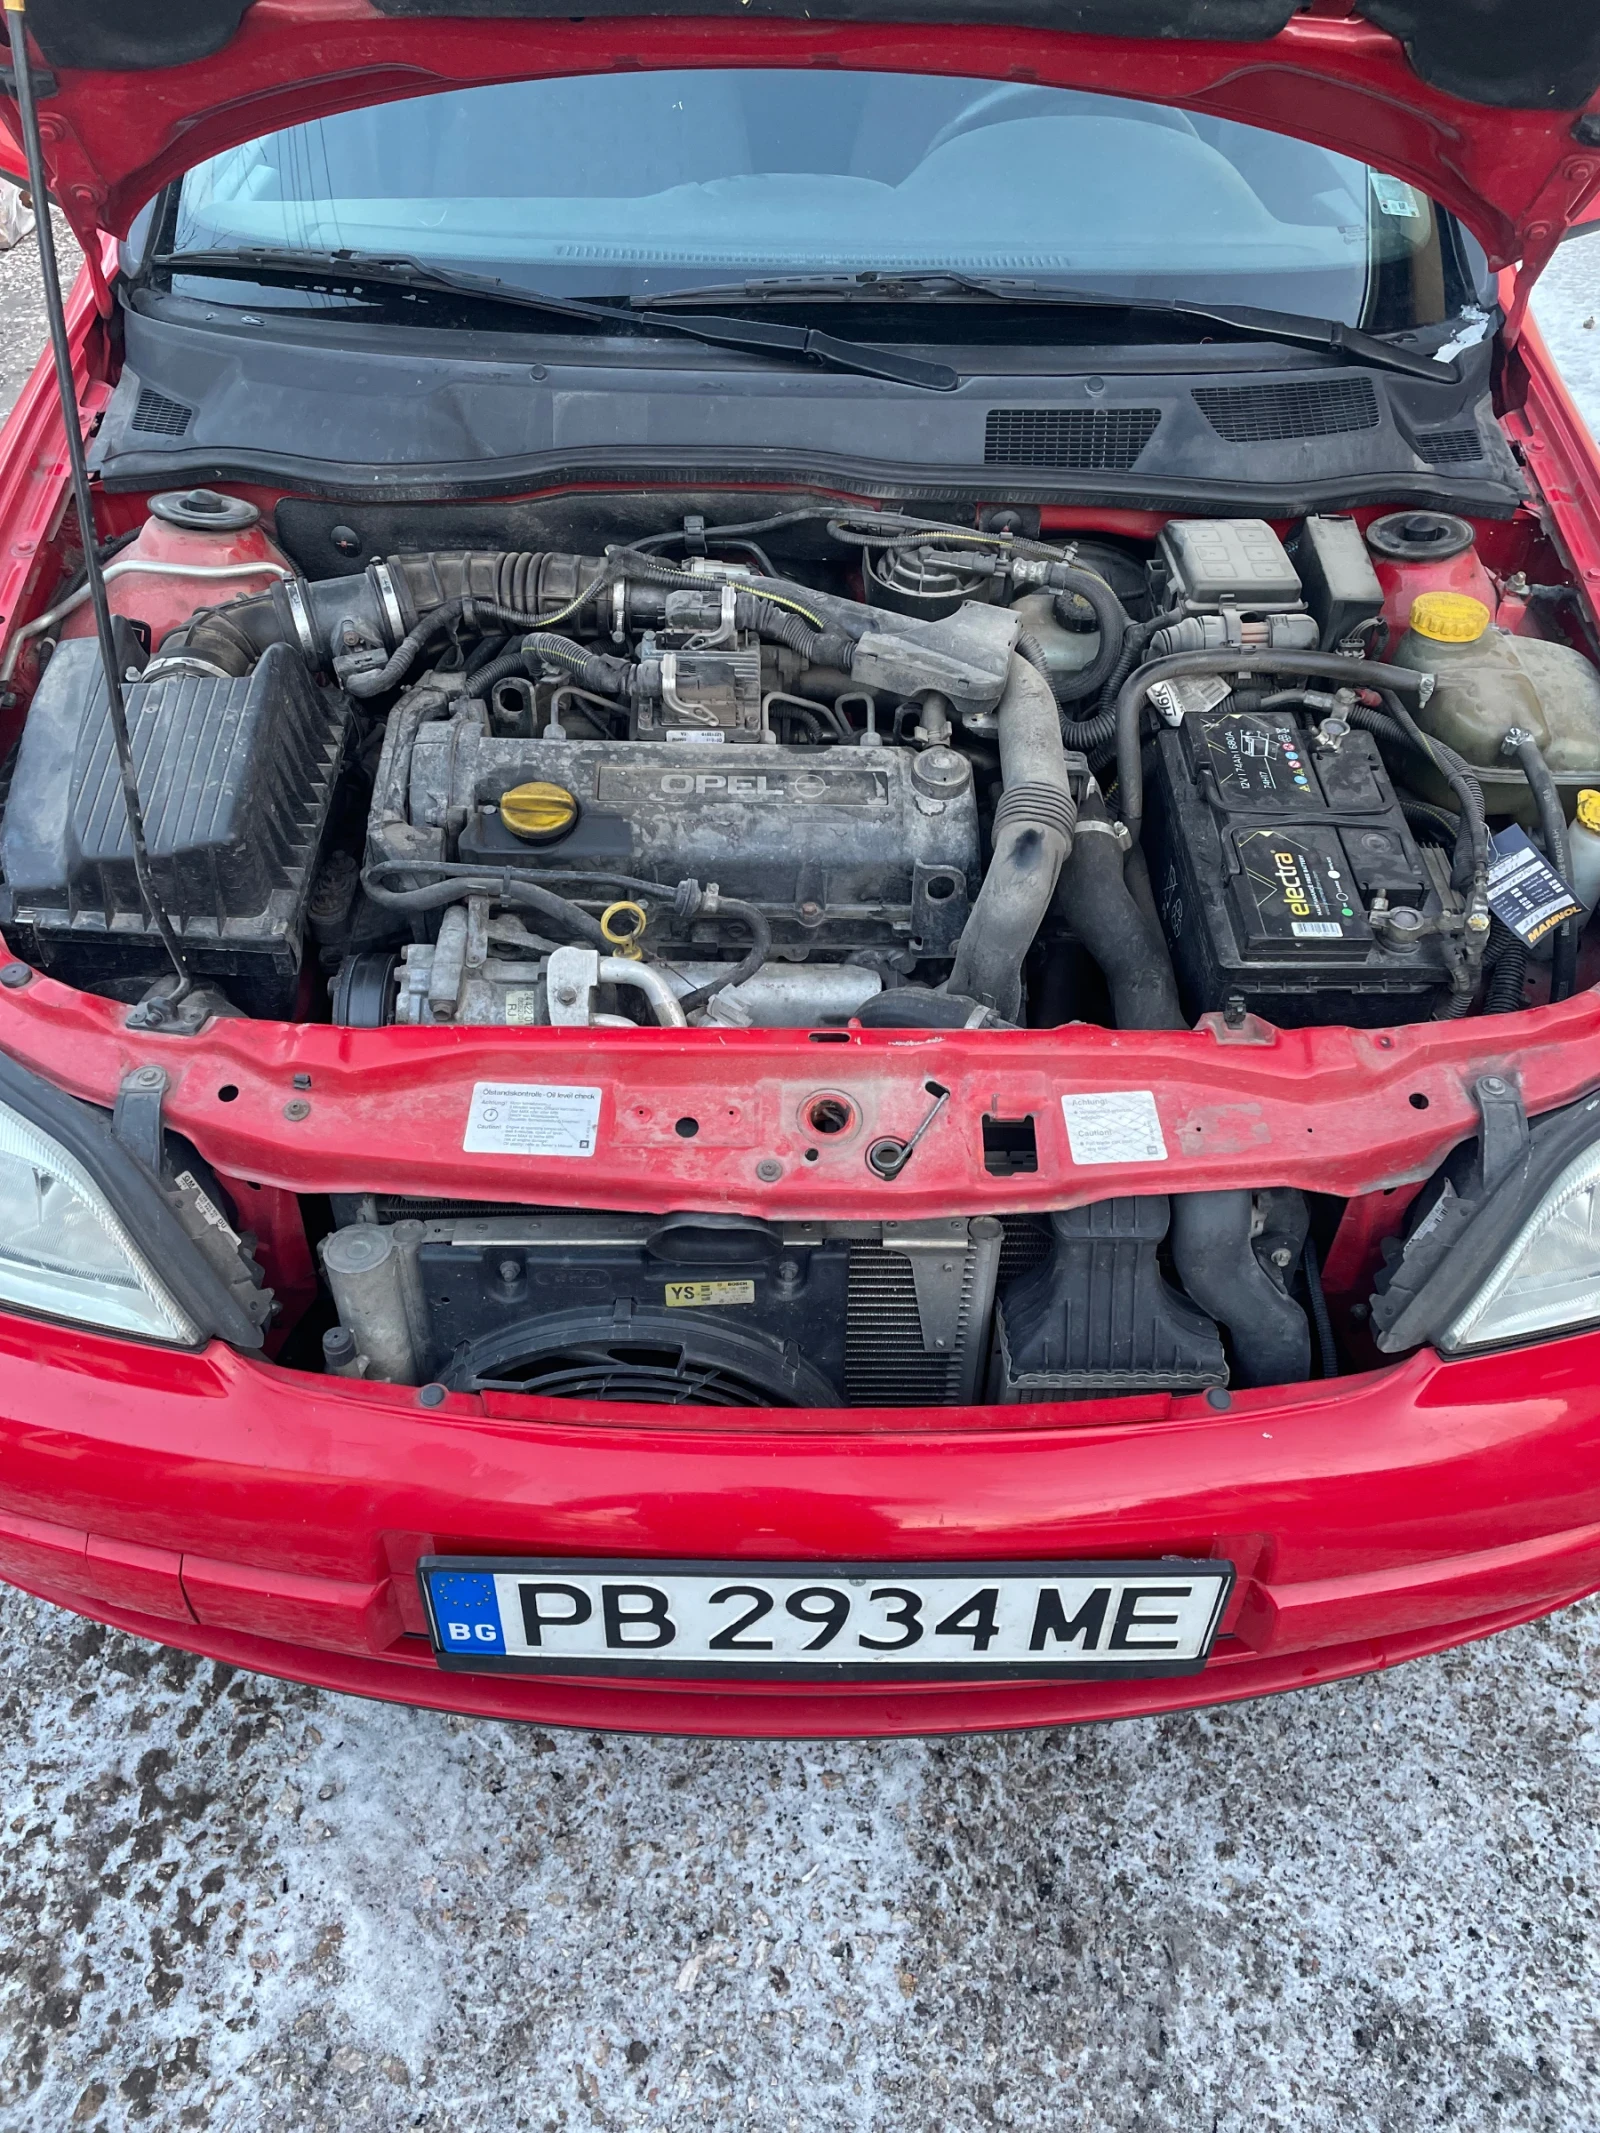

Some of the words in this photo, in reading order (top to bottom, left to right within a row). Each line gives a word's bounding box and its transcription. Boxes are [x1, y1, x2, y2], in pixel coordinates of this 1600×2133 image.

[1151, 683, 1173, 717] H6K
[1224, 731, 1238, 750] 680A
[1232, 753, 1246, 773] 74Ah
[661, 774, 784, 795] OPEL
[1239, 776, 1250, 789] 12V
[1274, 852, 1310, 916] electra
[1527, 906, 1582, 943] MANNOL
[507, 1003, 517, 1017] RJ
[557, 1091, 573, 1099] level
[1078, 1129, 1112, 1138] Caution!
[671, 1286, 695, 1300] YS
[517, 1583, 676, 1649] PB
[708, 1586, 1000, 1651] 2934
[1028, 1587, 1193, 1651] ME
[447, 1622, 497, 1642] BG
